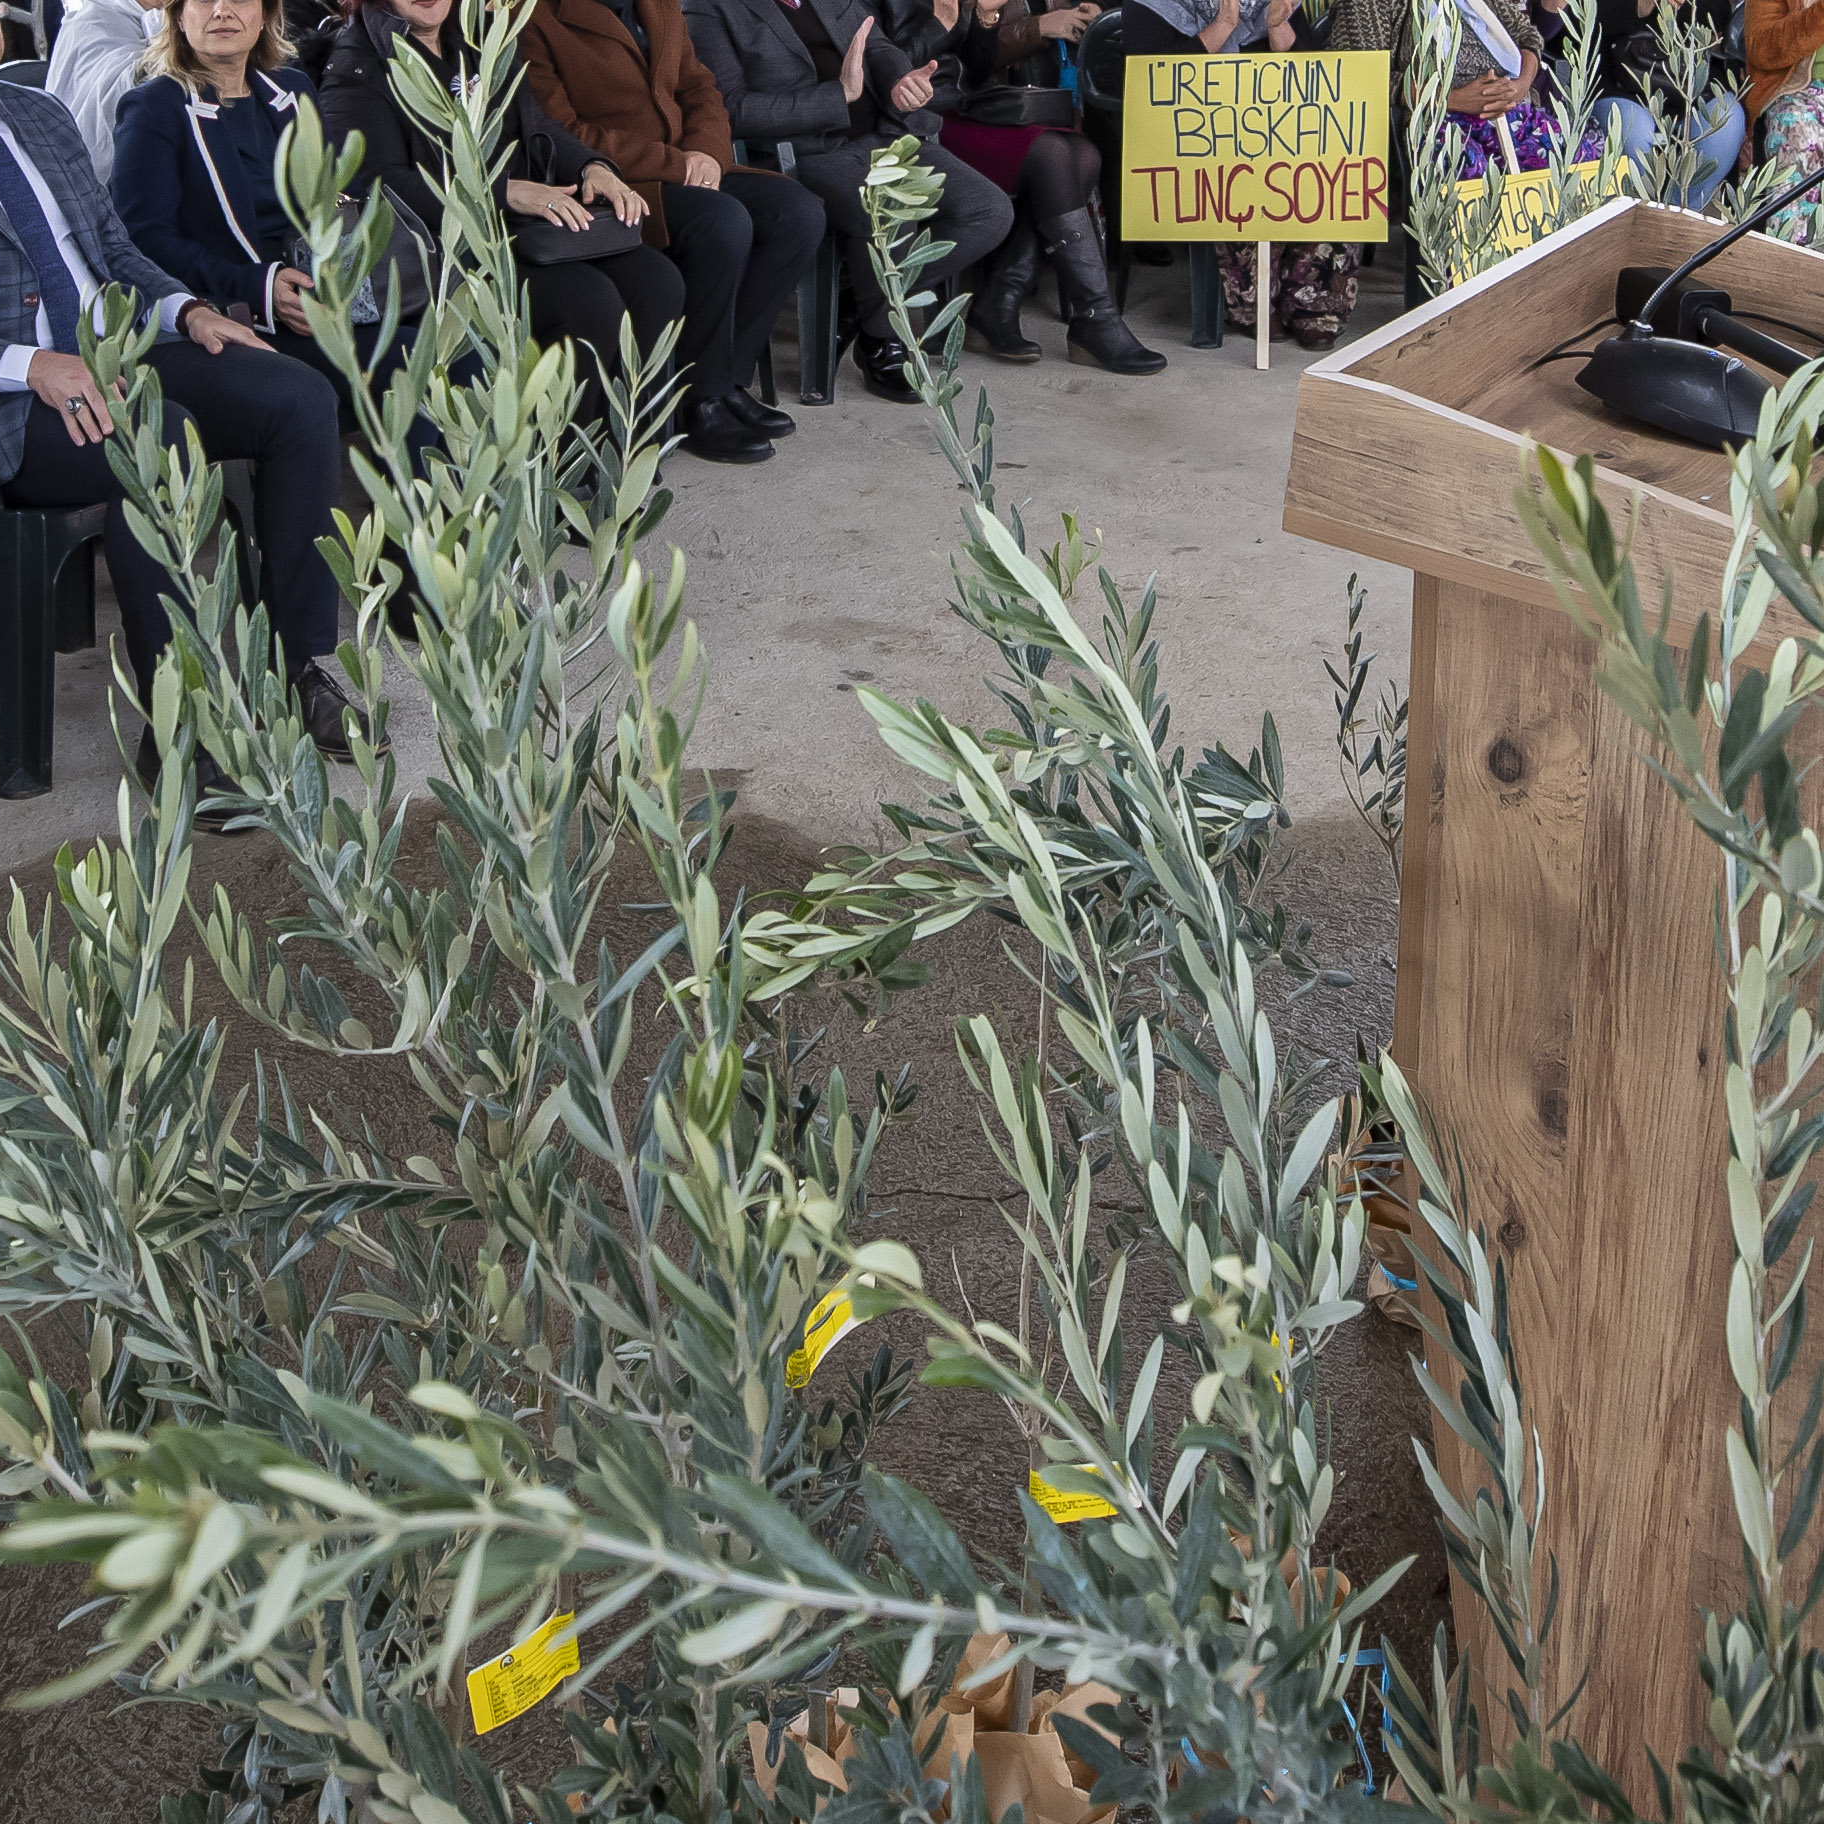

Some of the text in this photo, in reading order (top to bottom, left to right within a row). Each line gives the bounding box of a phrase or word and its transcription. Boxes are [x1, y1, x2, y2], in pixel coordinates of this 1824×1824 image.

[1174, 101, 1367, 161] BAŞKANI
[1131, 163, 1254, 232] TUNÇ
[1261, 156, 1389, 222] SOYER
